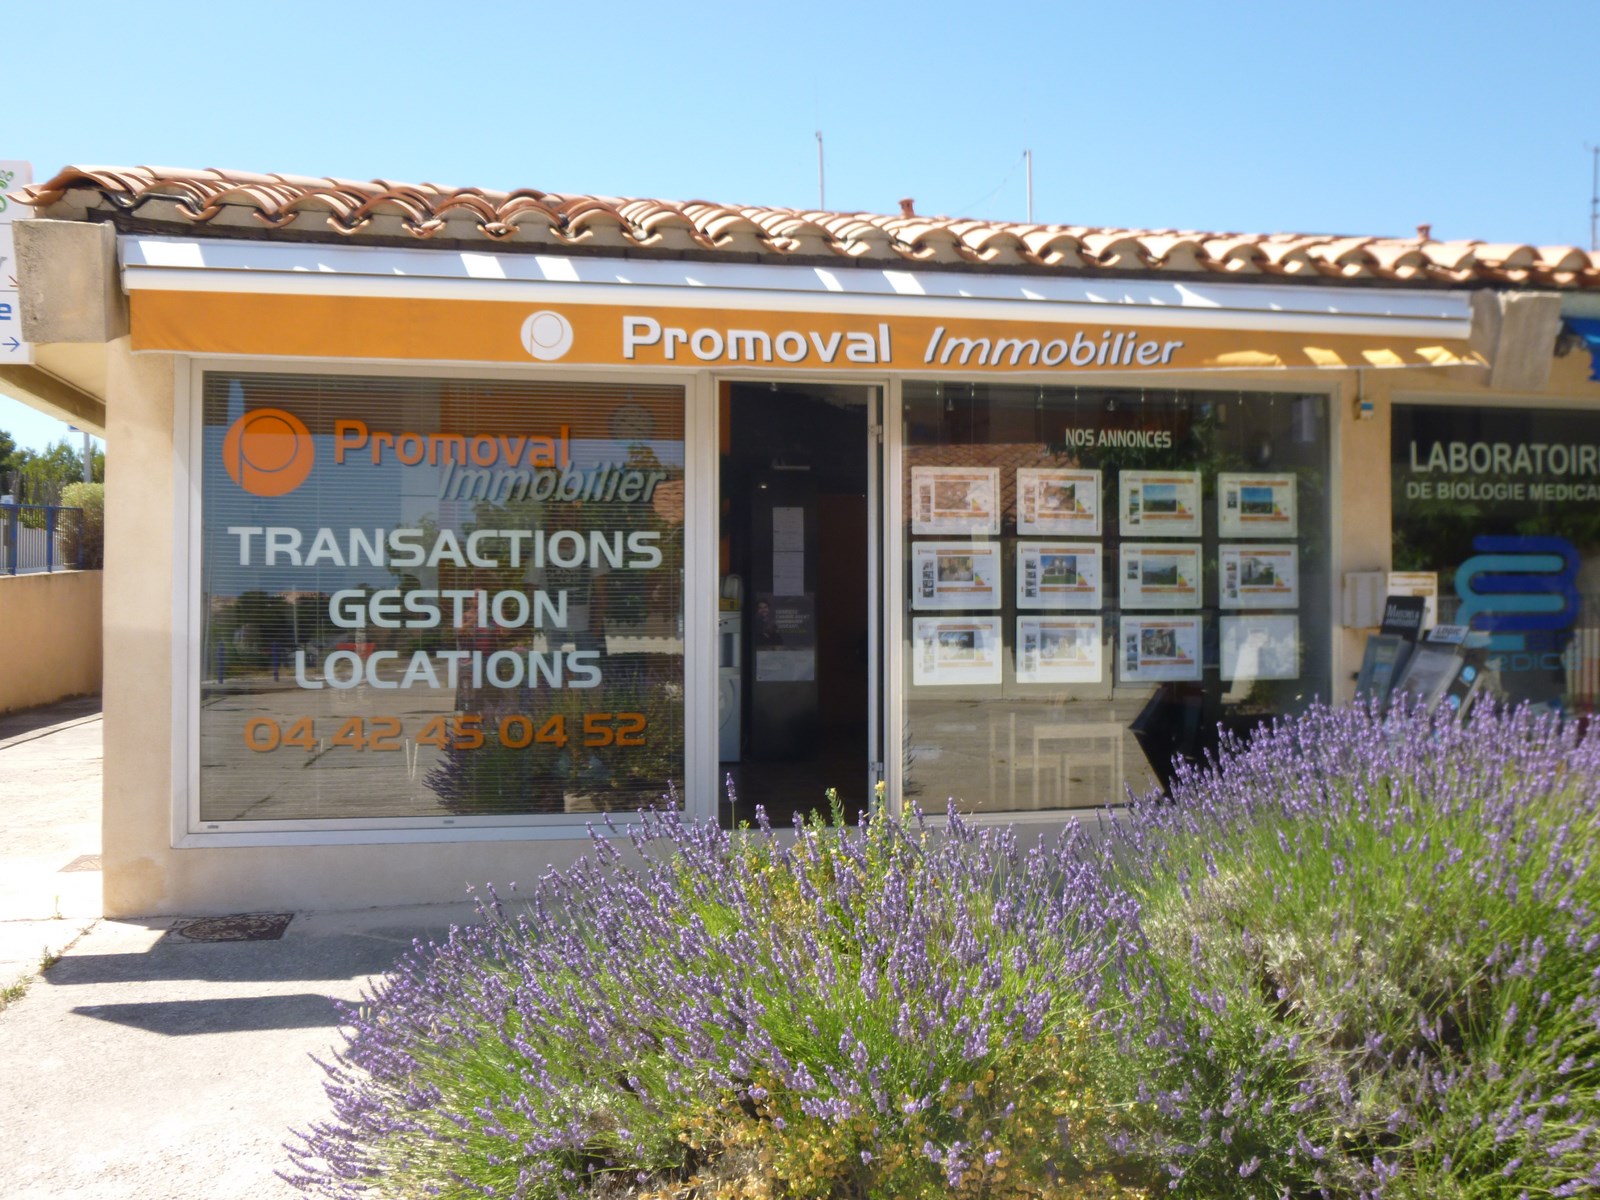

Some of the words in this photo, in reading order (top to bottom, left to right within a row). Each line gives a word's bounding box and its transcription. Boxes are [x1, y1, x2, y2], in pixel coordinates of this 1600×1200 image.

[622, 315, 892, 363] Promoval
[923, 326, 1184, 367] Immobilier
[334, 419, 571, 468] Promoval
[1065, 428, 1095, 447] NOS
[1097, 429, 1172, 449] ANNONCES
[1410, 440, 1600, 475] LABORATOIR
[438, 458, 667, 502] Immobilier
[1407, 482, 1432, 499] DE
[1437, 482, 1526, 501] BIOLOGIE
[1529, 484, 1600, 501] MEDICA
[228, 526, 662, 568] TRANSACTIONS
[328, 589, 567, 629] GESTION
[295, 650, 602, 690] LOCATIONS
[243, 717, 320, 753] 04
[331, 716, 402, 752] 42
[414, 715, 484, 751] 45
[499, 714, 569, 749] 04
[583, 711, 649, 748] 52
